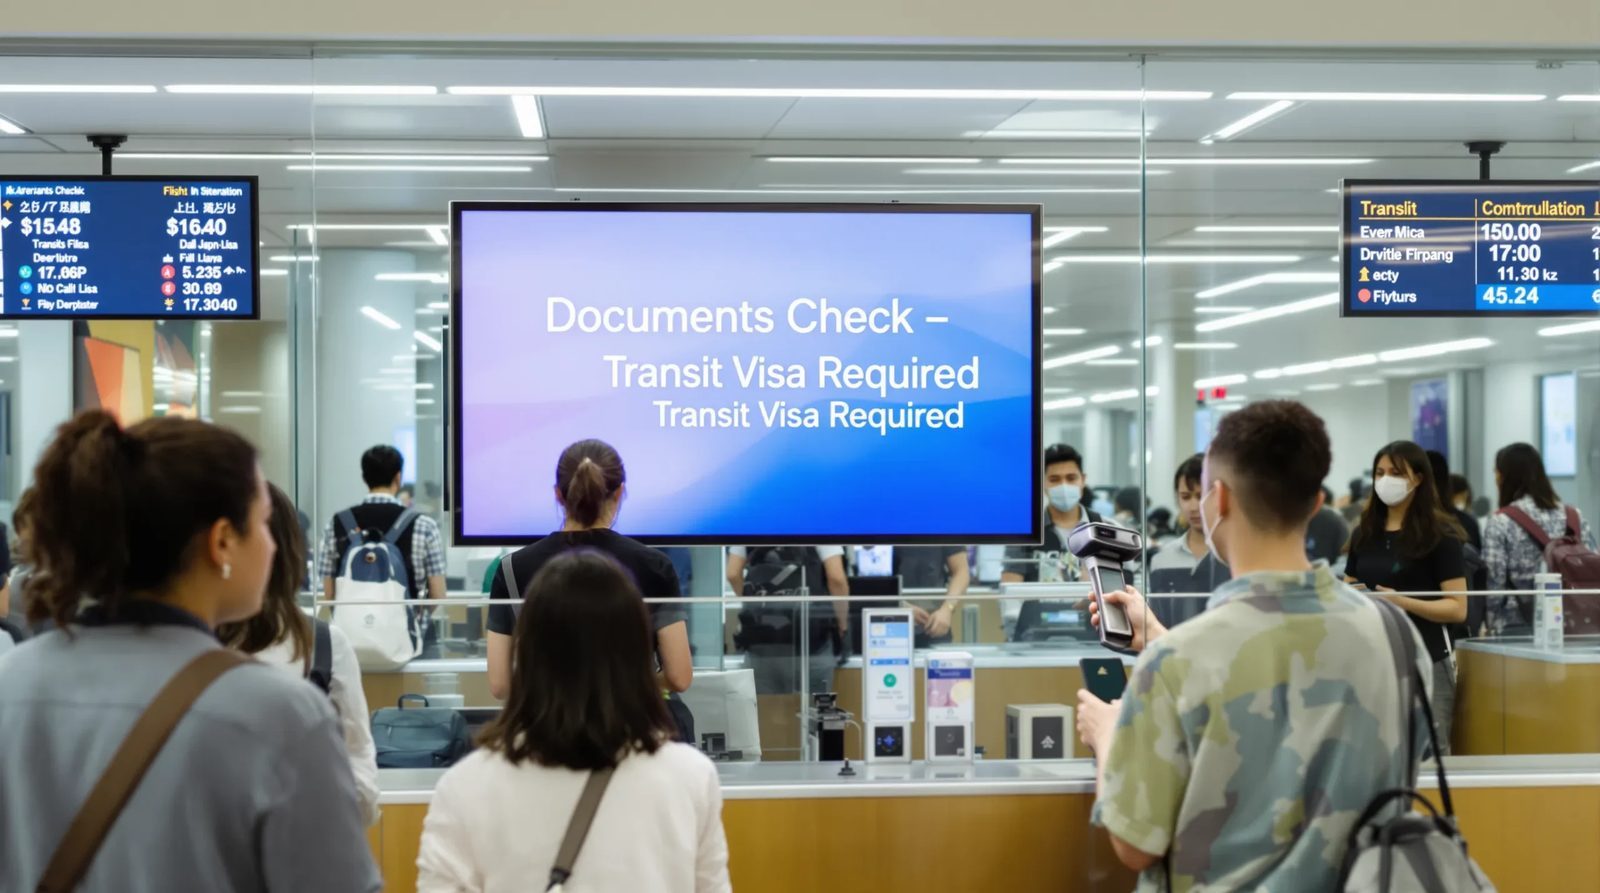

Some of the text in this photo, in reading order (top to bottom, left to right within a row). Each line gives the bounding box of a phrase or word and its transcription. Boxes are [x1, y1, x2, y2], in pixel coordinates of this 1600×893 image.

[1360, 201, 1417, 215] Translit
[21, 217, 81, 236] $15.48
[166, 217, 227, 236] $16.40
[1394, 226, 1425, 238] Mica
[1481, 223, 1541, 240] 150.00
[1489, 244, 1541, 261] 17:00
[182, 265, 222, 279] 5.235
[1373, 270, 1399, 283] ecty
[1542, 268, 1558, 280] kz
[1482, 286, 1539, 304] 45.24
[183, 298, 238, 311] 17.3040
[546, 297, 775, 334] Documents
[787, 297, 914, 335] Check
[603, 355, 980, 398] Transit Visa Required
[653, 401, 965, 436] Transit Visa Required
